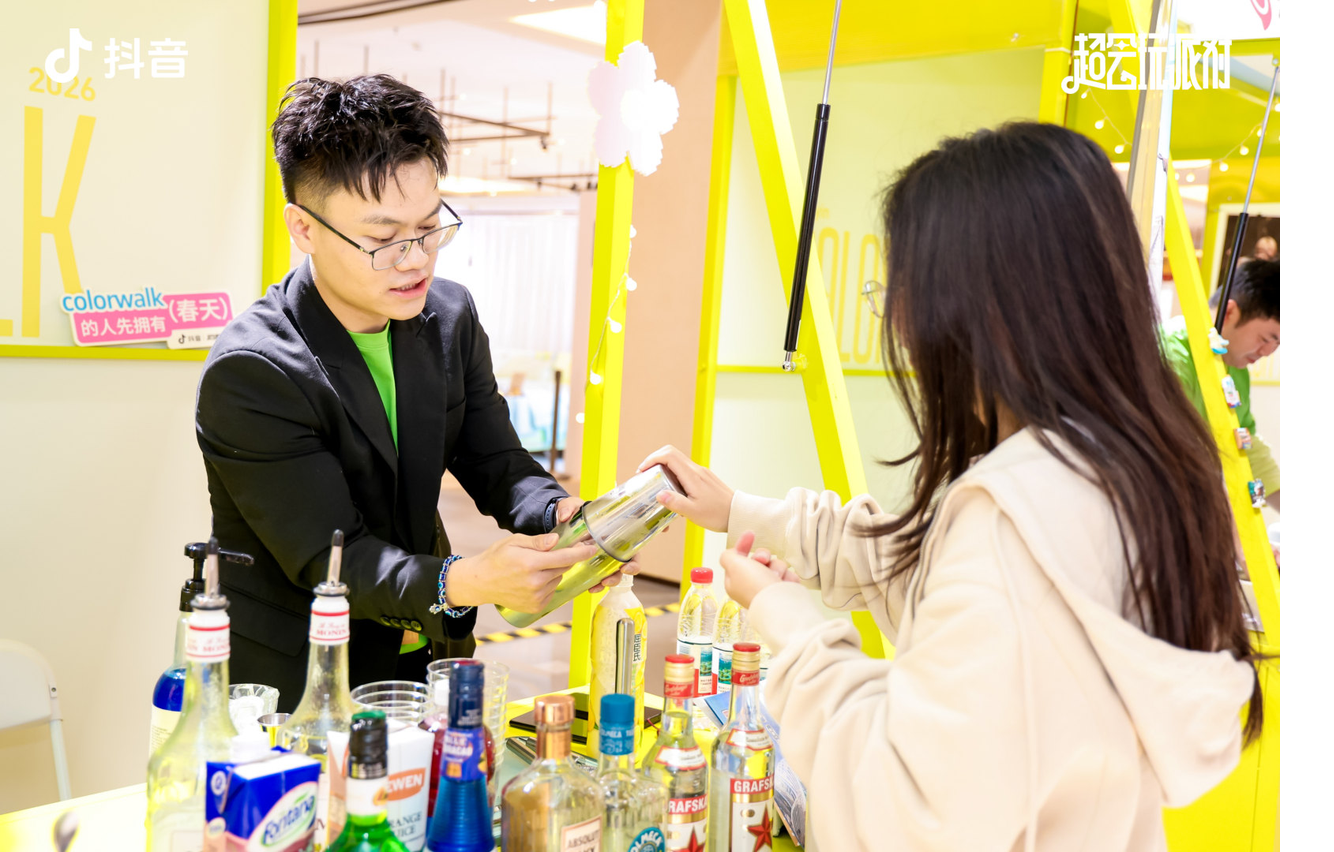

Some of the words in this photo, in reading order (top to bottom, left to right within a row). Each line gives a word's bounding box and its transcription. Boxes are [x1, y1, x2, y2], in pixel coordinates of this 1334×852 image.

[62, 287, 165, 312] colorwalk
[80, 316, 167, 338] 的人先拥有
[387, 773, 423, 794] EWEN
[389, 811, 423, 828] RANGE
